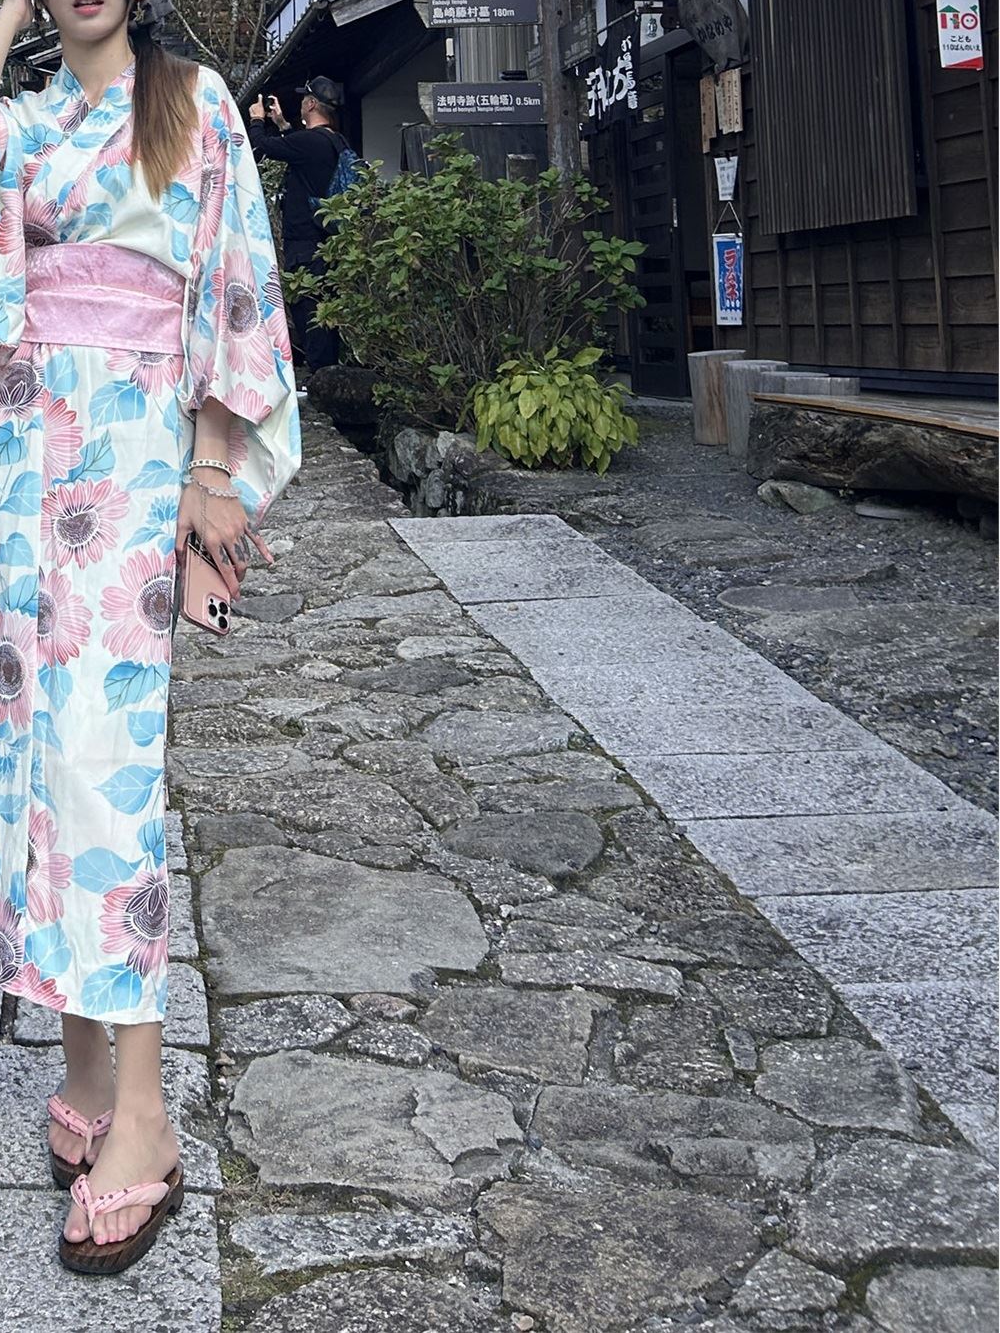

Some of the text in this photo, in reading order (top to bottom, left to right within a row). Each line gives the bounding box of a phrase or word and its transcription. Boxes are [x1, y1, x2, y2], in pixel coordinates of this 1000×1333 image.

[433, 7, 515, 18] 島崎藤村墓 180m
[950, 35, 971, 43] こども
[516, 97, 541, 106] 0.5km
[724, 248, 739, 301] ラムネ
